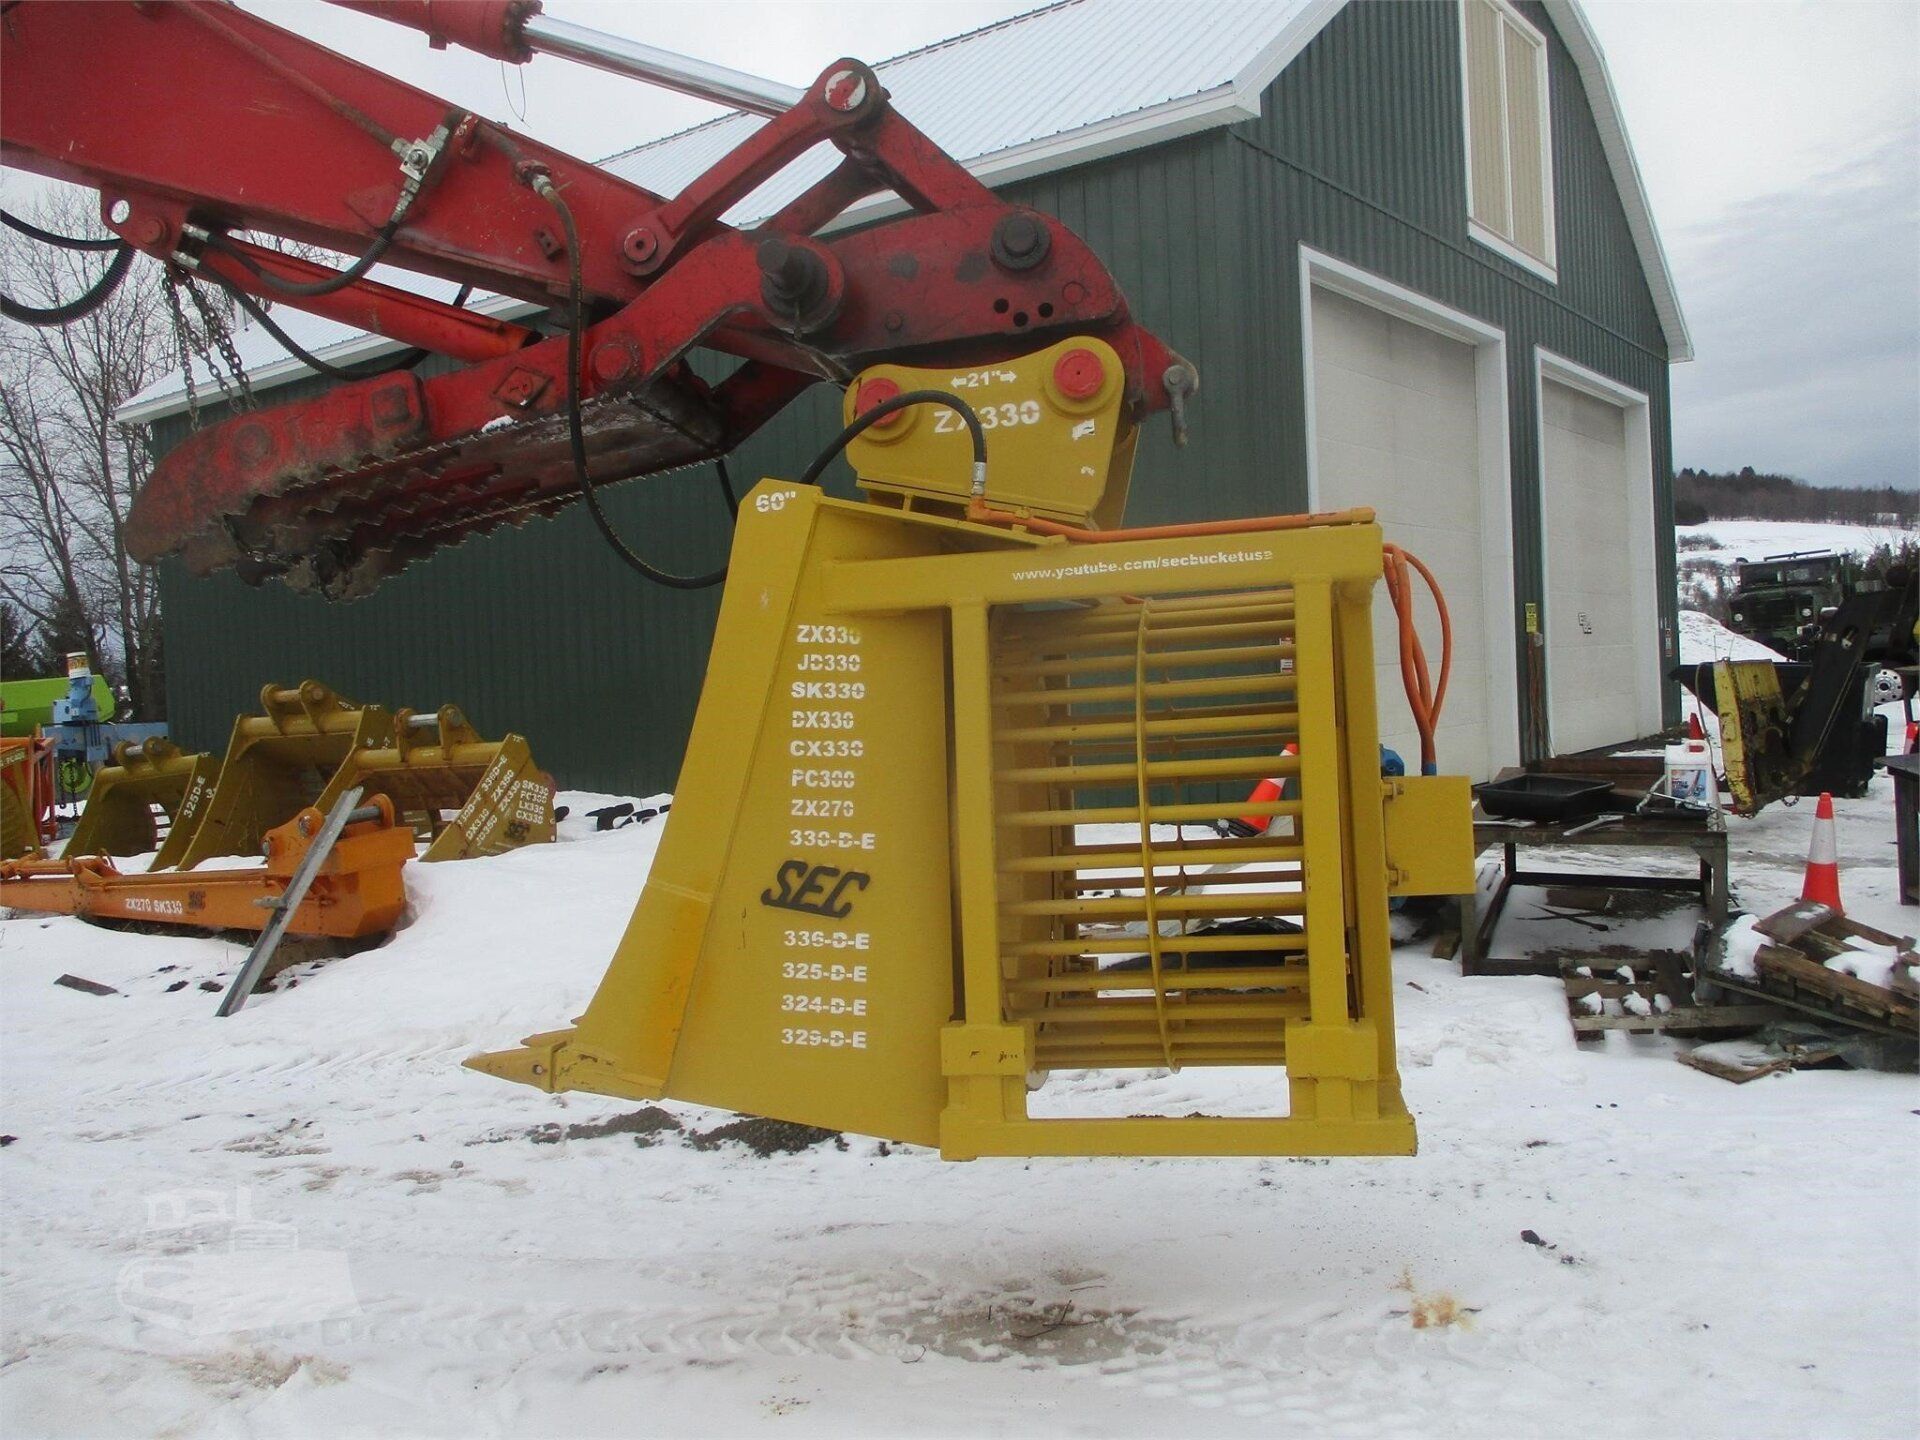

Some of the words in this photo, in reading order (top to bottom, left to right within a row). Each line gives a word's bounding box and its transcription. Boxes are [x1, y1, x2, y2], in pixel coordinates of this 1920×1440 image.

[756, 491, 796, 512] 60"
[796, 624, 862, 645] ZX330
[797, 654, 861, 672] JD330
[791, 681, 865, 699] SK330
[792, 711, 854, 729] DX330
[790, 740, 864, 757] CX330
[791, 768, 855, 788] PC300
[183, 775, 206, 818] 325D-E
[790, 799, 854, 817] ZX270
[789, 829, 876, 849] 330-D-E
[760, 860, 871, 919] SEC
[784, 930, 870, 950] 336-D-E
[782, 962, 868, 982] 325-D-E
[781, 994, 868, 1016] 324-D-E
[781, 1028, 868, 1048] 329-D-E
